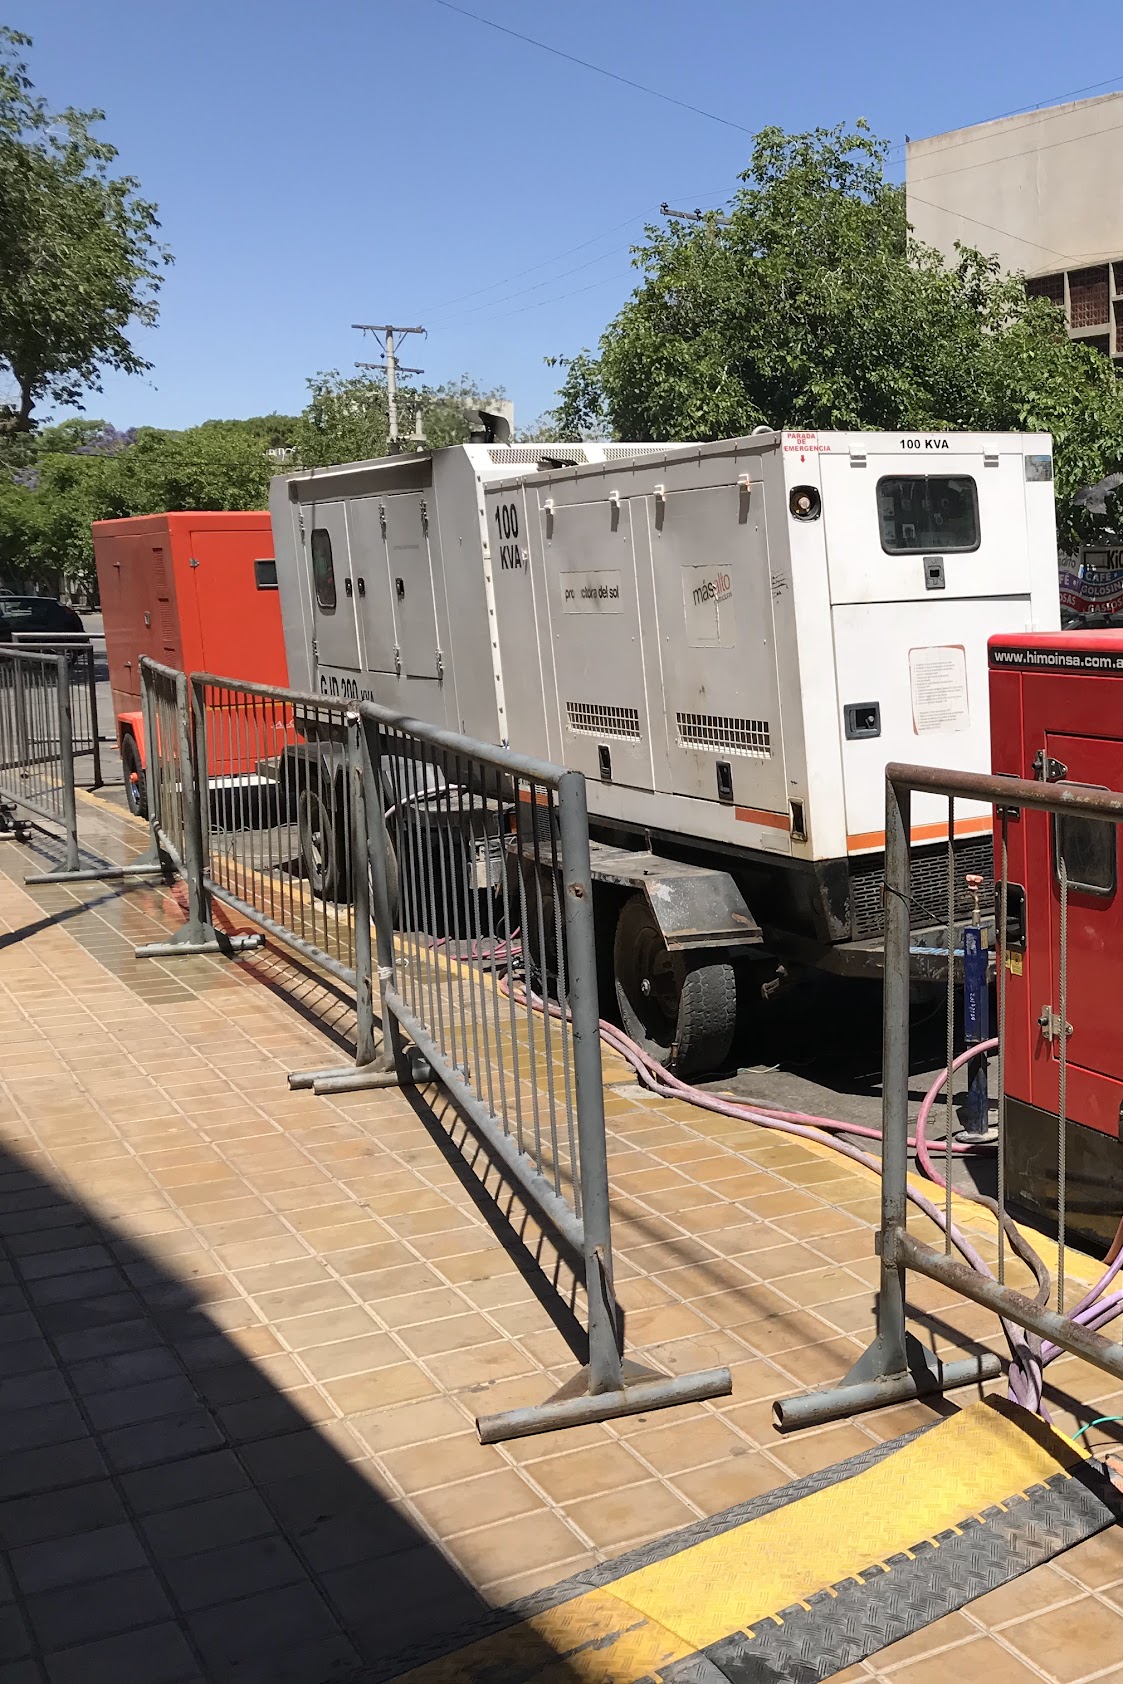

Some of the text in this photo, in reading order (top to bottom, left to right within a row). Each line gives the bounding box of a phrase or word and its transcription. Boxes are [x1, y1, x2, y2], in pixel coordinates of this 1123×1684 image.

[899, 439, 949, 449] 100 KVA
[495, 503, 518, 540] 100
[499, 544, 522, 570] KVA
[609, 585, 619, 599] sol
